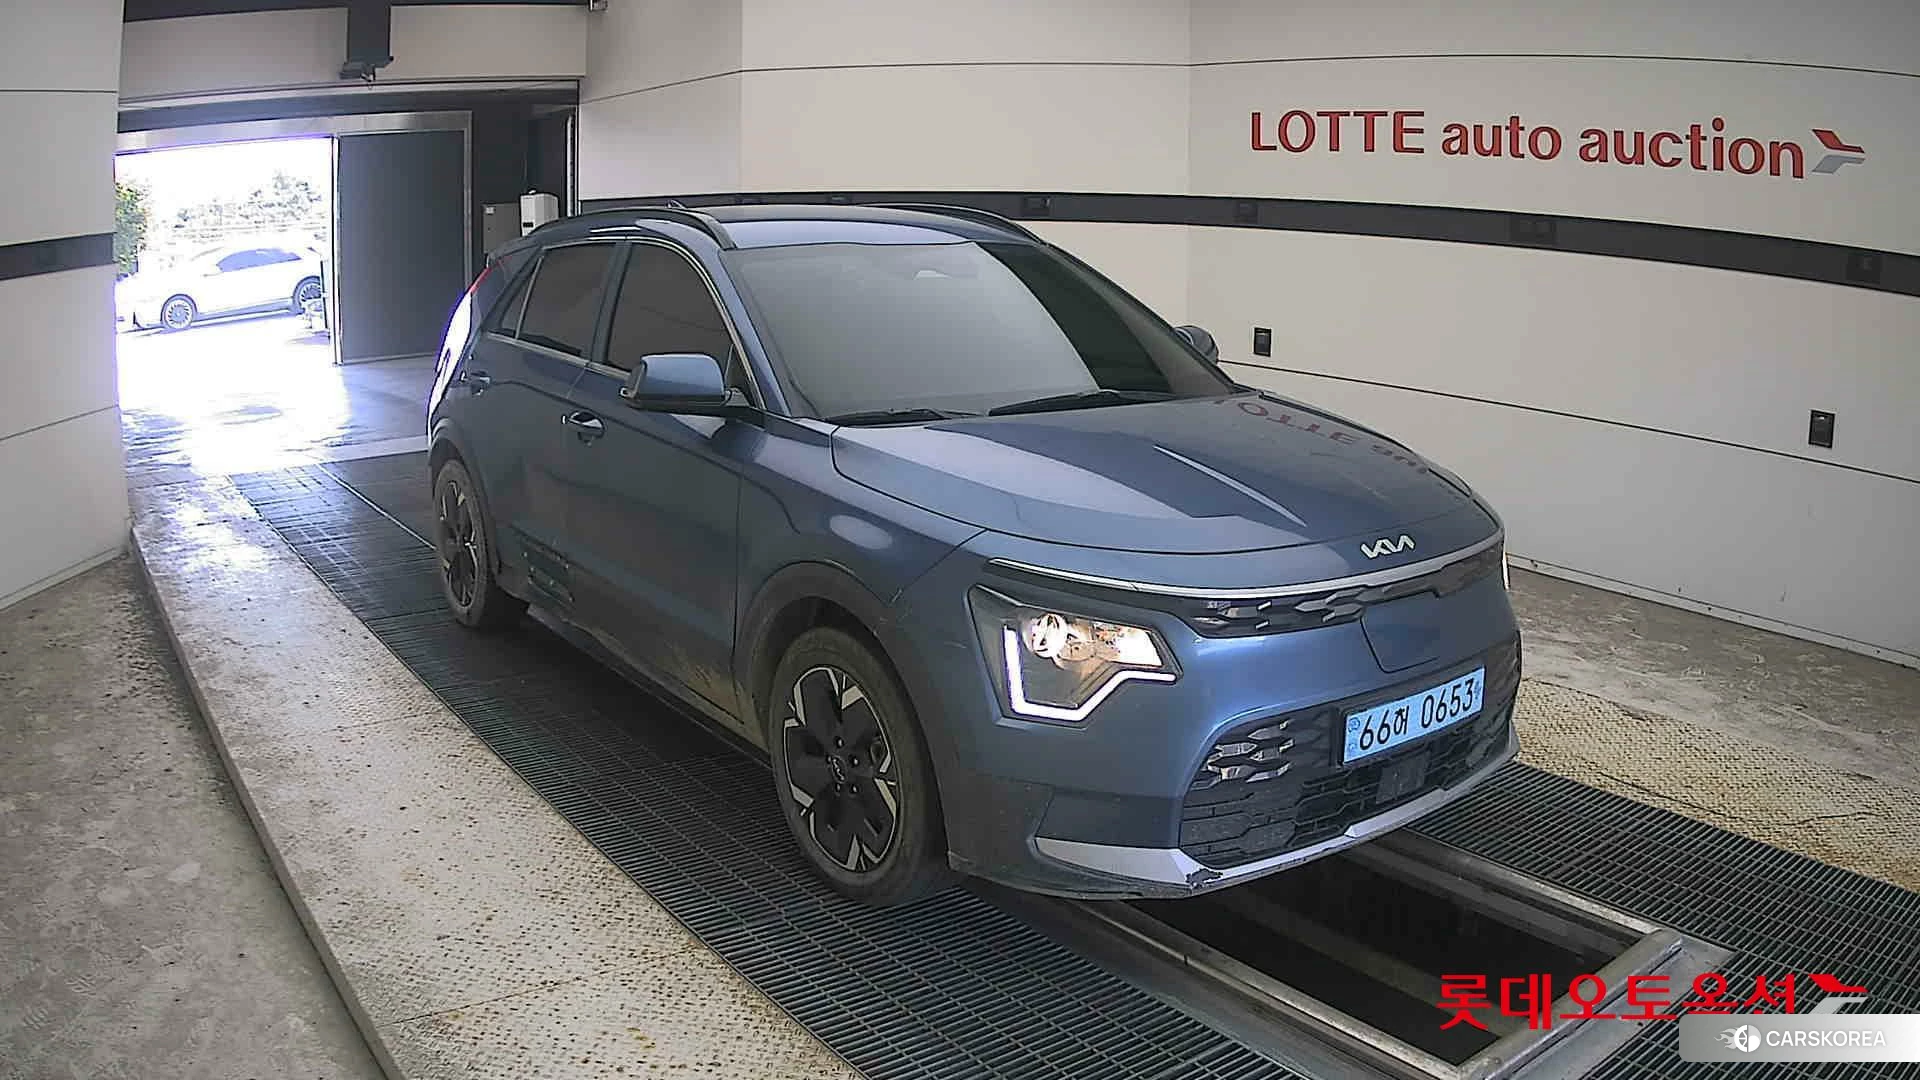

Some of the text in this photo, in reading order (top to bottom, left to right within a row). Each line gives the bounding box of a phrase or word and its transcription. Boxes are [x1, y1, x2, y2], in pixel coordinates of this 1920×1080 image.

[1251, 109, 1806, 179] LOTTE auto auction
[1420, 677, 1475, 729] 0653
